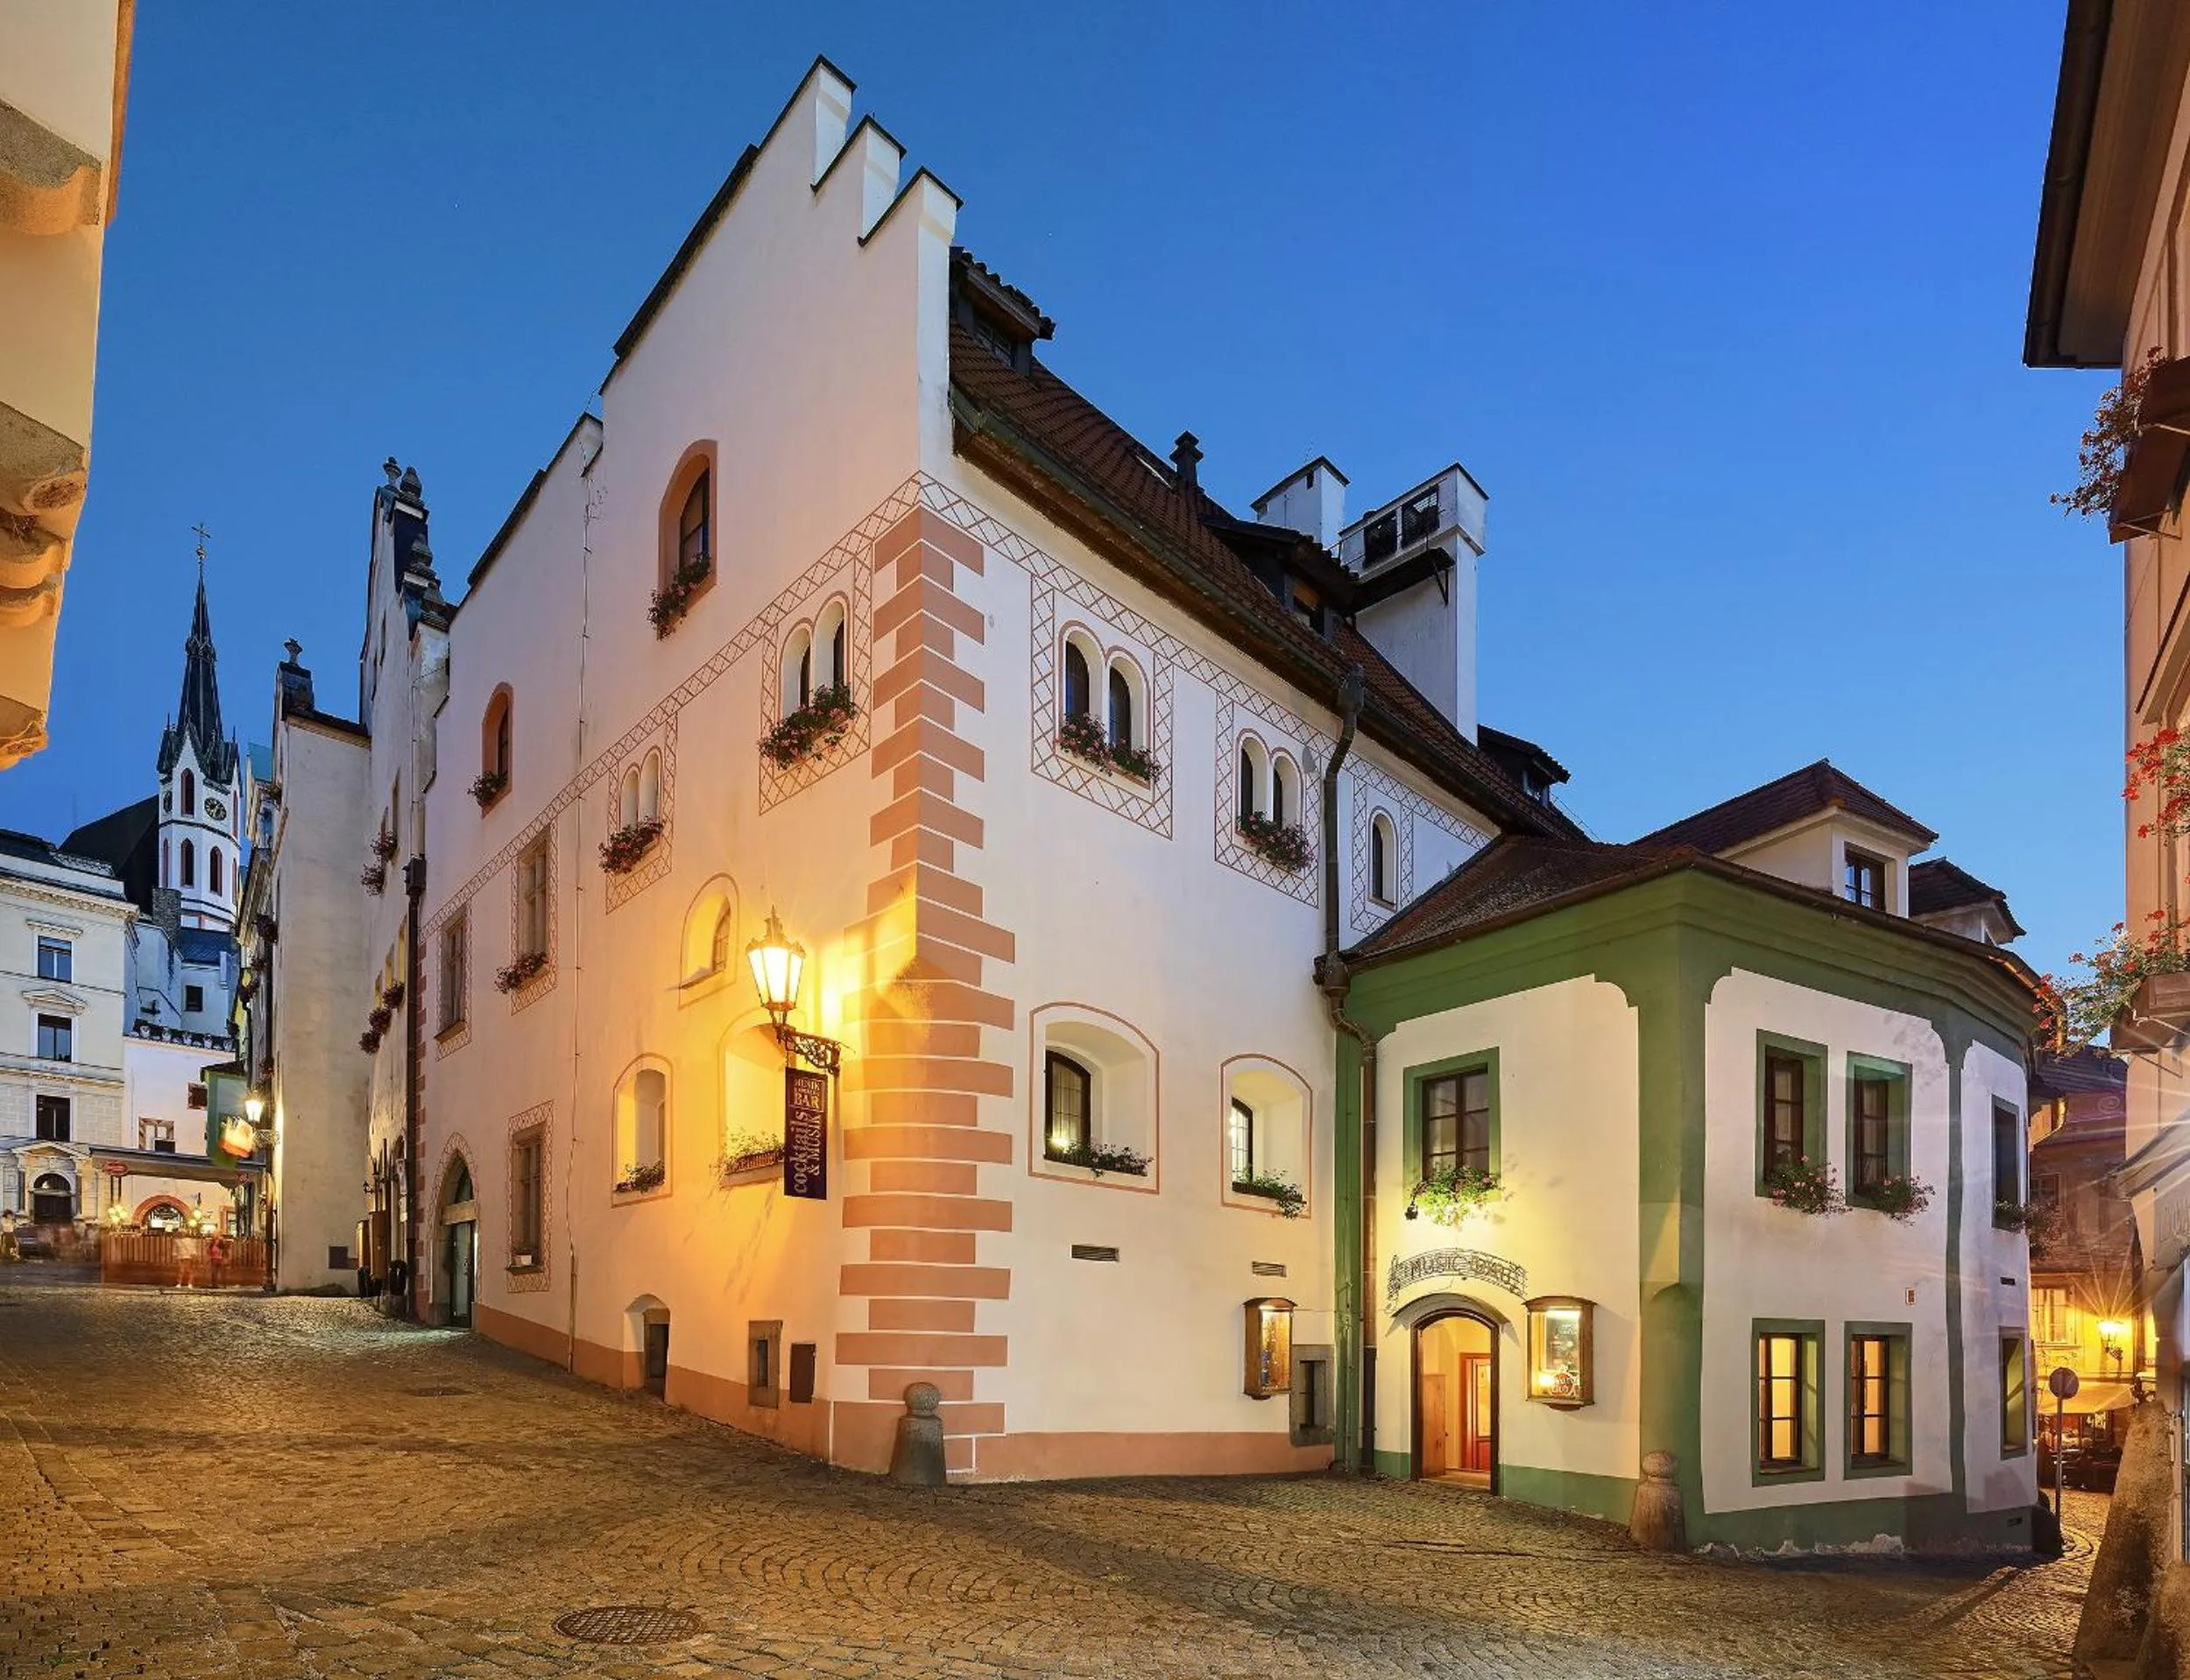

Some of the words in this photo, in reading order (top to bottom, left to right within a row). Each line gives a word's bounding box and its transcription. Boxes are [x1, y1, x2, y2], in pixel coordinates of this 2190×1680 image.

[794, 1092, 820, 1109] BAR
[808, 1113, 821, 1161] MUSIK
[790, 1111, 809, 1193] cocktails
[808, 1164, 820, 1176] &
[1409, 1253, 1467, 1280] MUSIC
